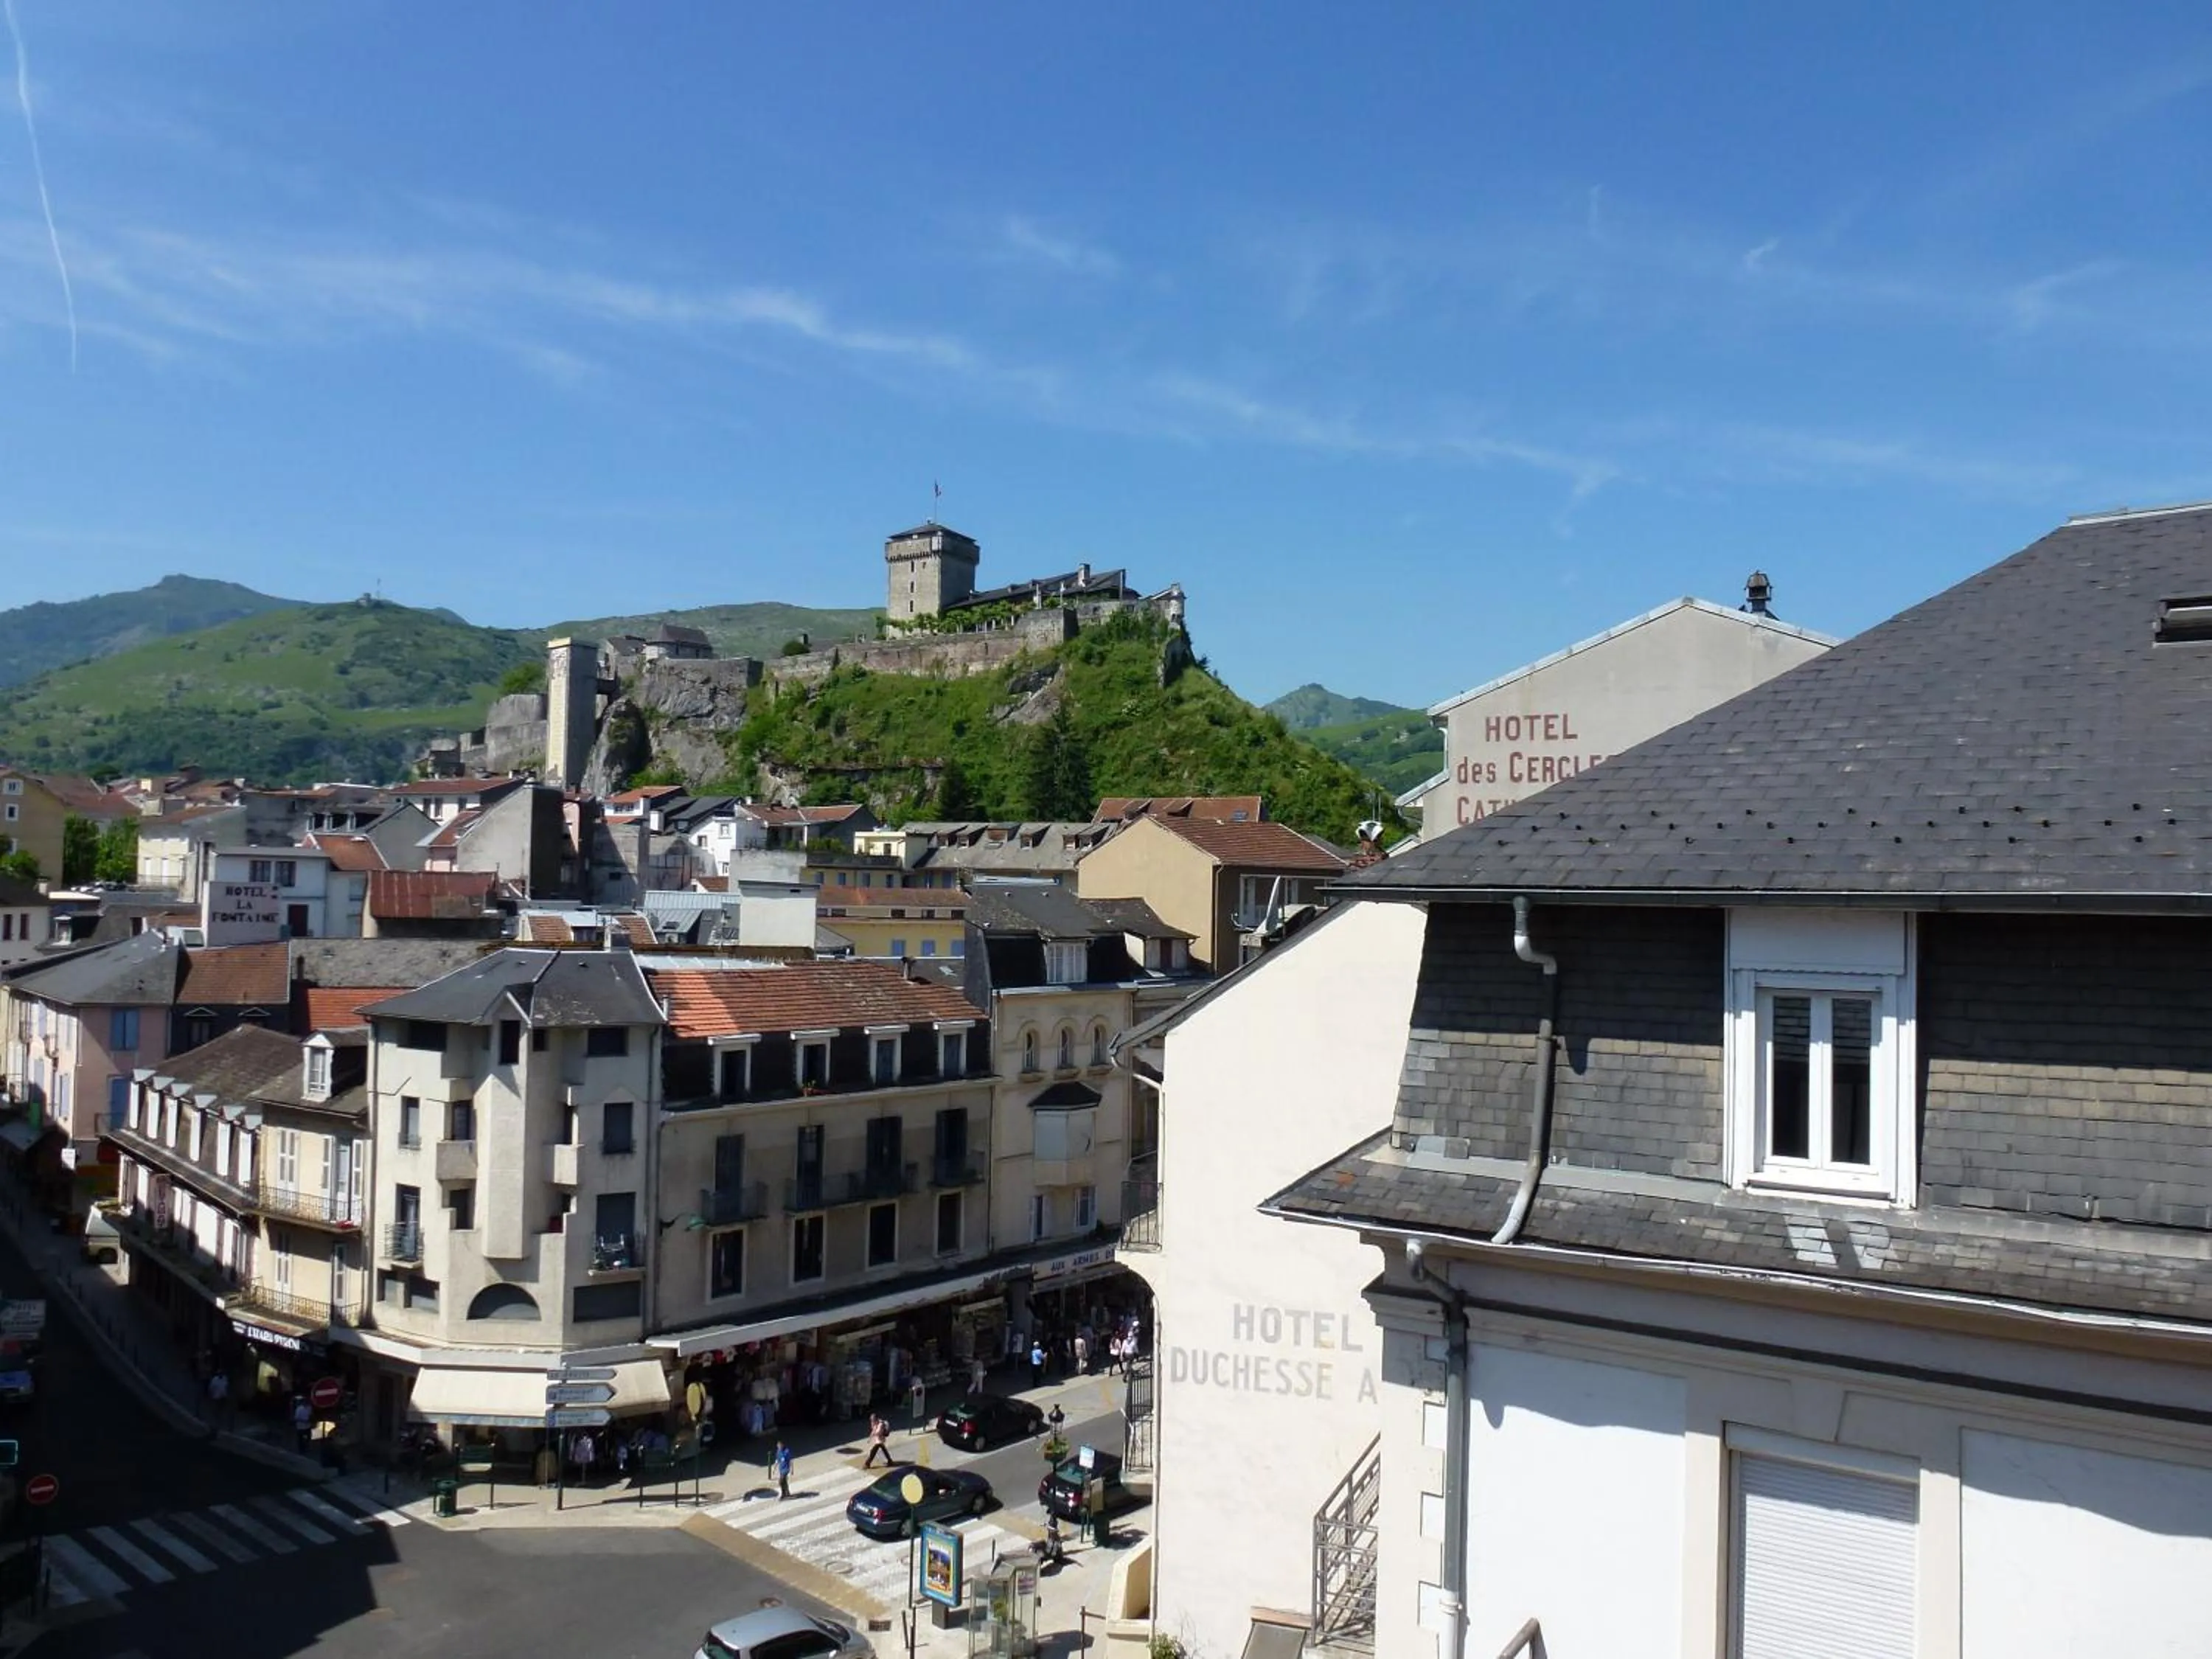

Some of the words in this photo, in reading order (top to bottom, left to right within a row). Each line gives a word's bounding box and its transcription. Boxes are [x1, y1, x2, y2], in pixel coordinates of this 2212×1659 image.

[1486, 714, 1578, 742] HOTEL
[1457, 757, 1497, 785] des
[1509, 751, 1613, 783] CERCL
[1457, 796, 1516, 825] CAT
[226, 886, 266, 897] HOTEL
[237, 900, 253, 909] LA
[212, 912, 279, 922] FONTAINE
[1233, 1304, 1363, 1352] HOTEL
[1170, 1346, 1334, 1401] DUCHESSE
